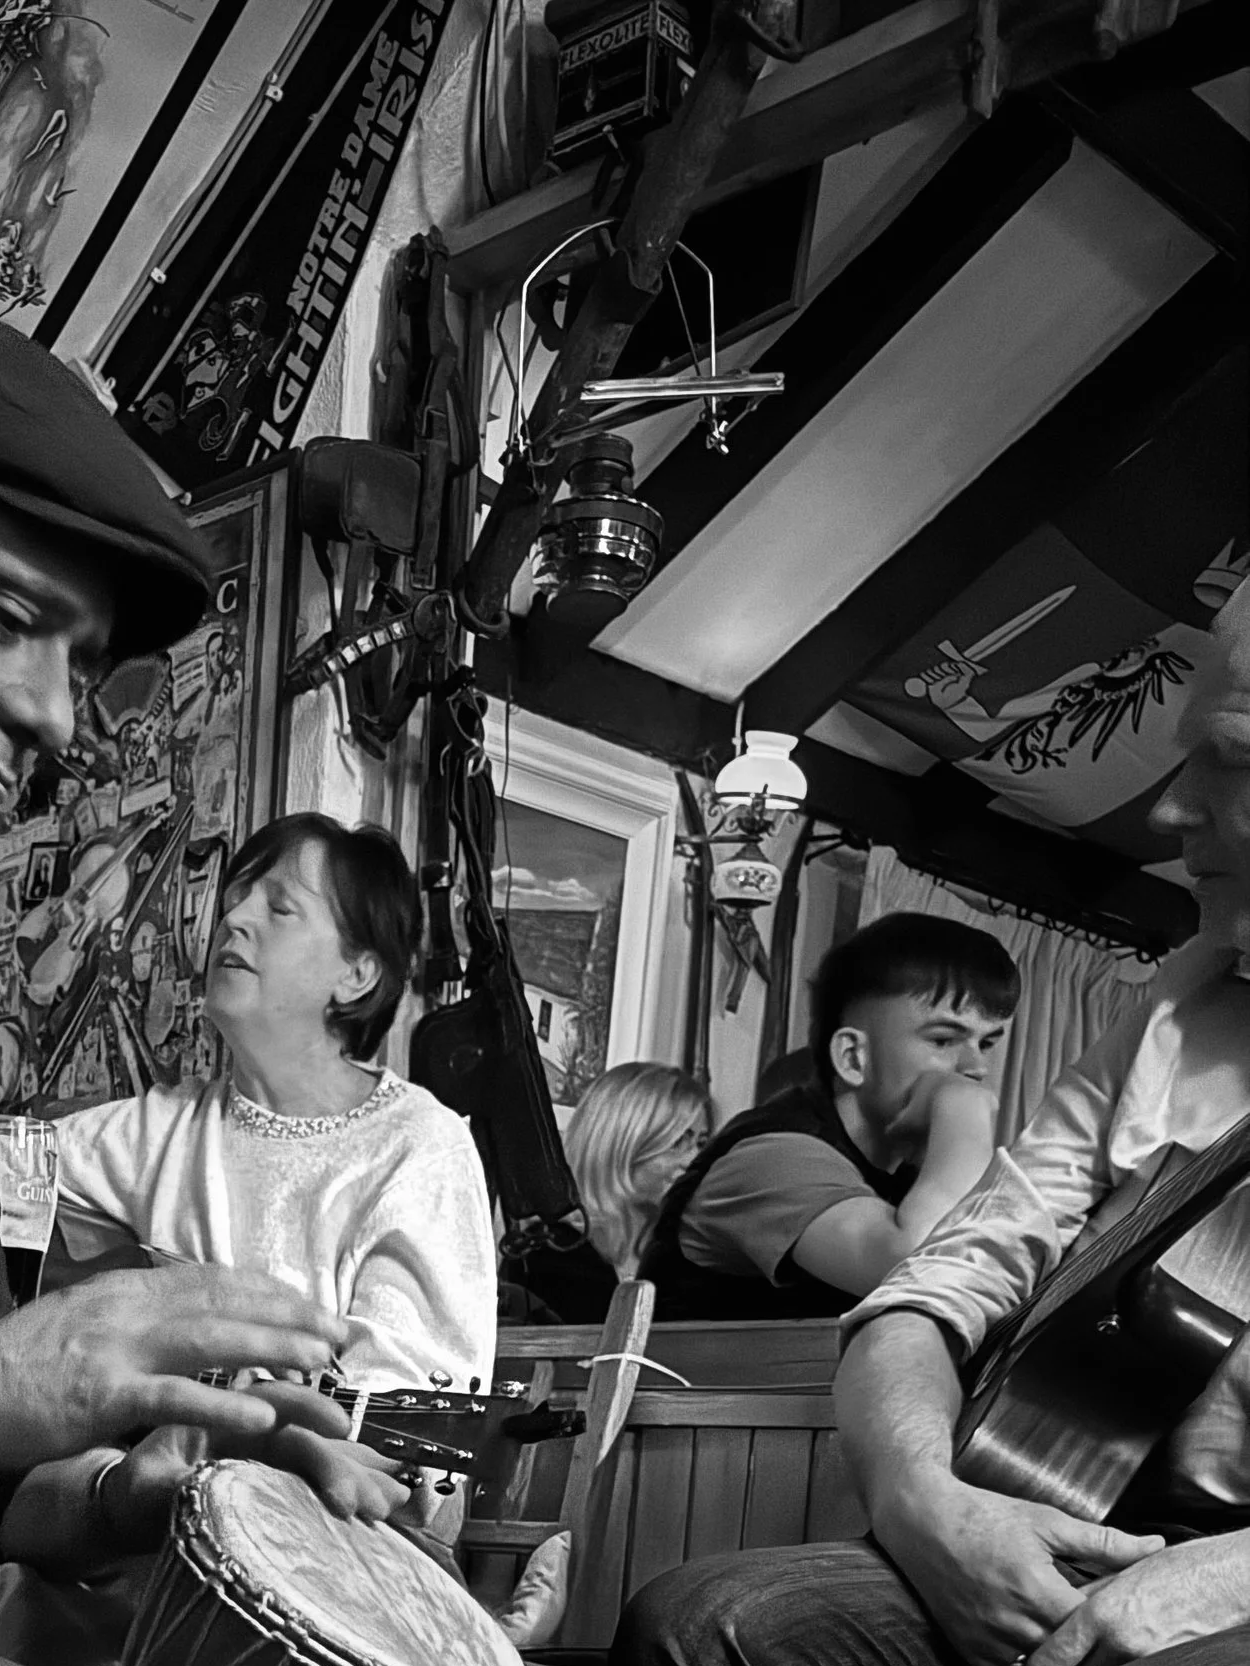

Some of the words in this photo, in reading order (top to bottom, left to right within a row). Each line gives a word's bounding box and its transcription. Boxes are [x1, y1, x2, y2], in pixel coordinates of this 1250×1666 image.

[560, 12, 650, 72] FLEXOLITE
[286, 168, 351, 316] NOTRE
[341, 30, 400, 169] DAME
